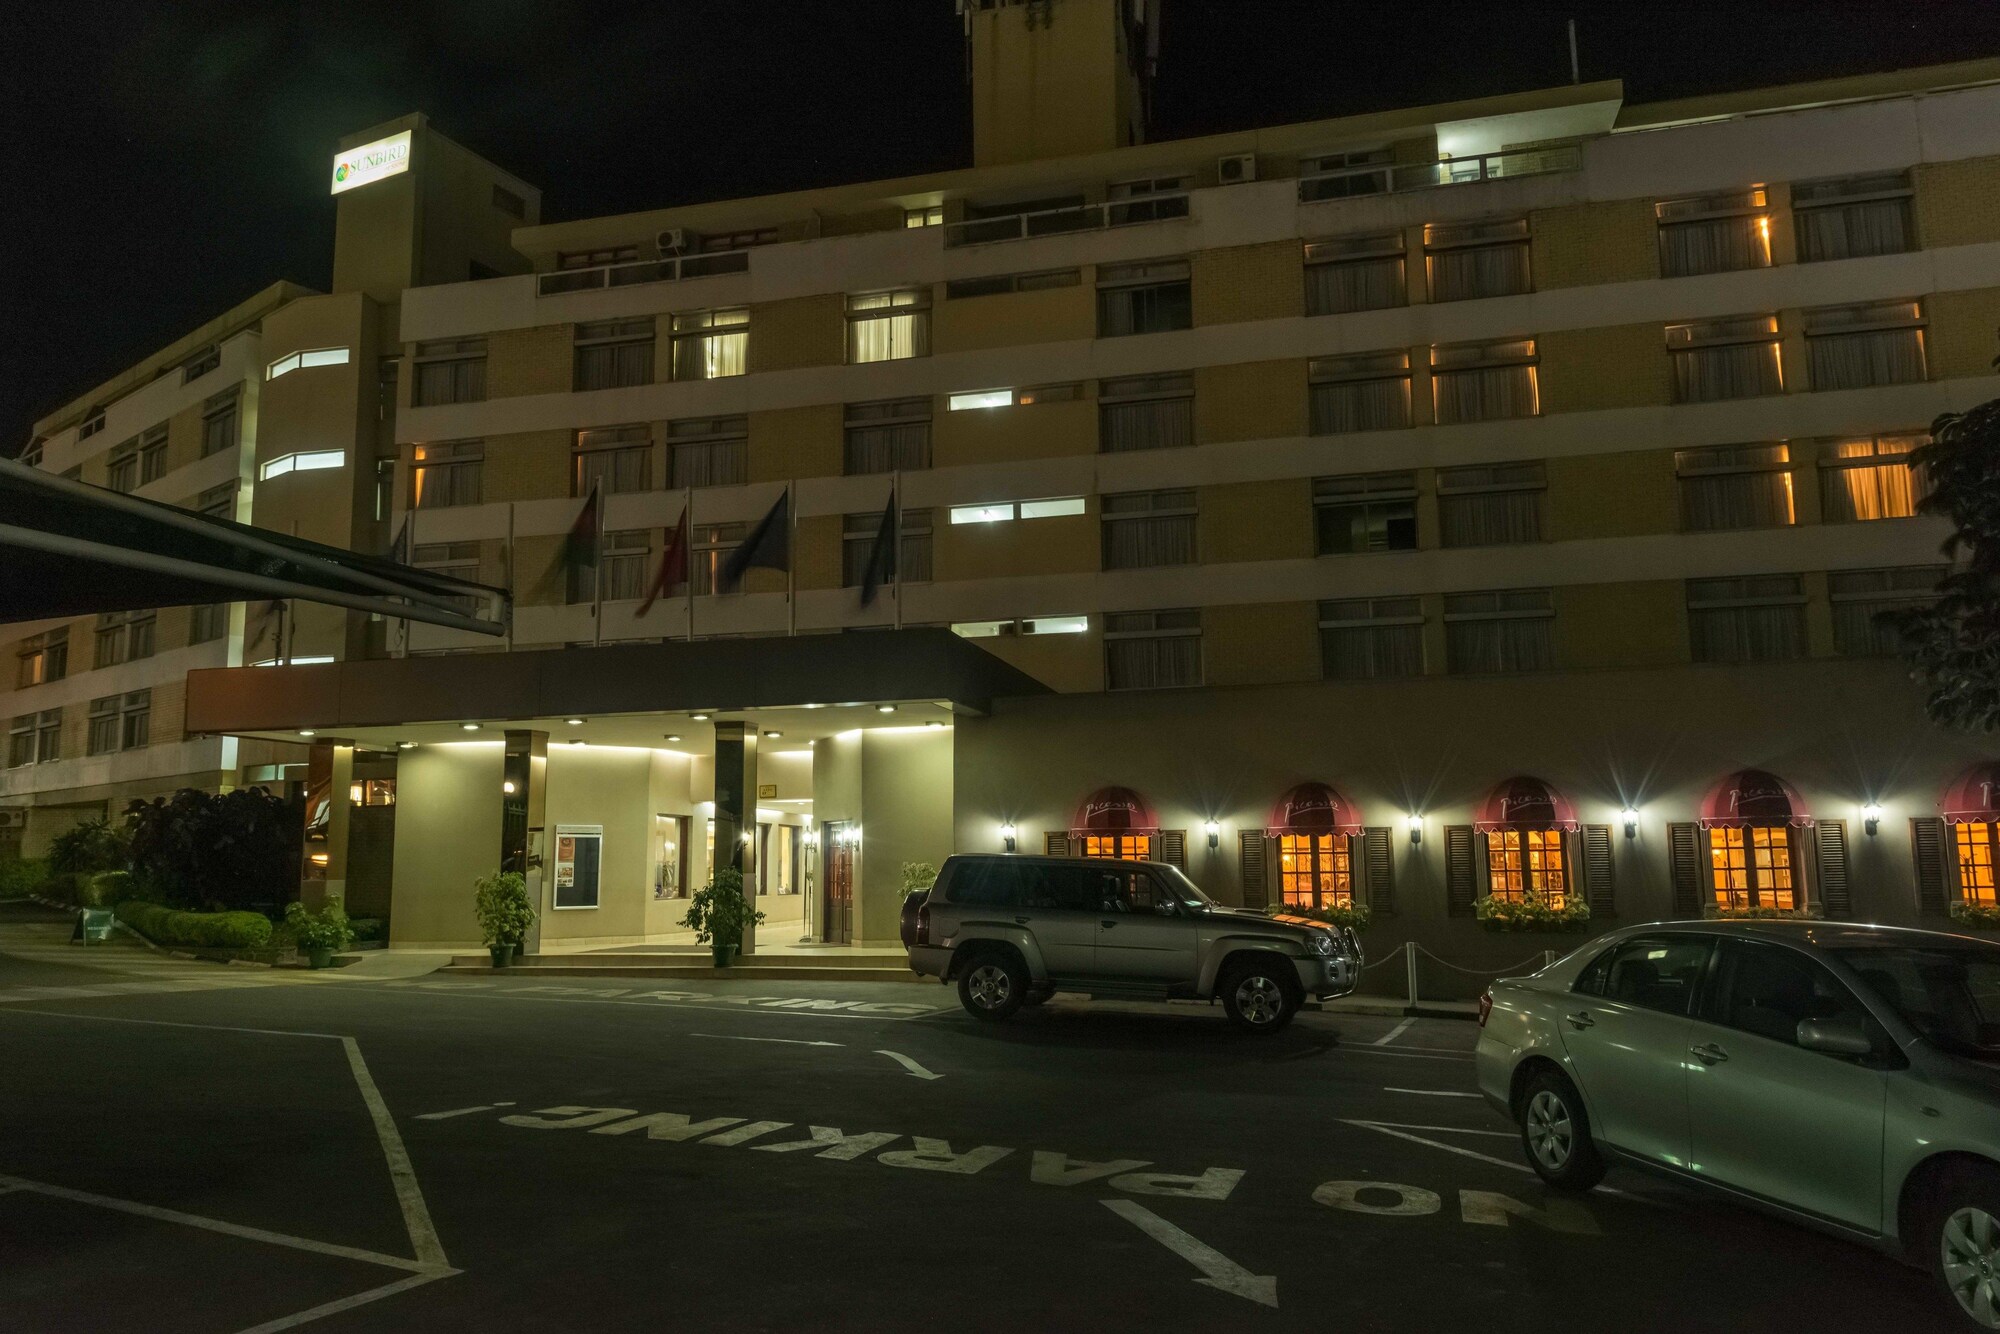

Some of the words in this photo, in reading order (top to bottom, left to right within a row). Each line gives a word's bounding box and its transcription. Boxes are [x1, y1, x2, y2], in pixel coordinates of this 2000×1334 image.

[350, 145, 407, 173] SUNBIRD
[492, 987, 938, 1014] PARKING
[1311, 1181, 1602, 1235] NO
